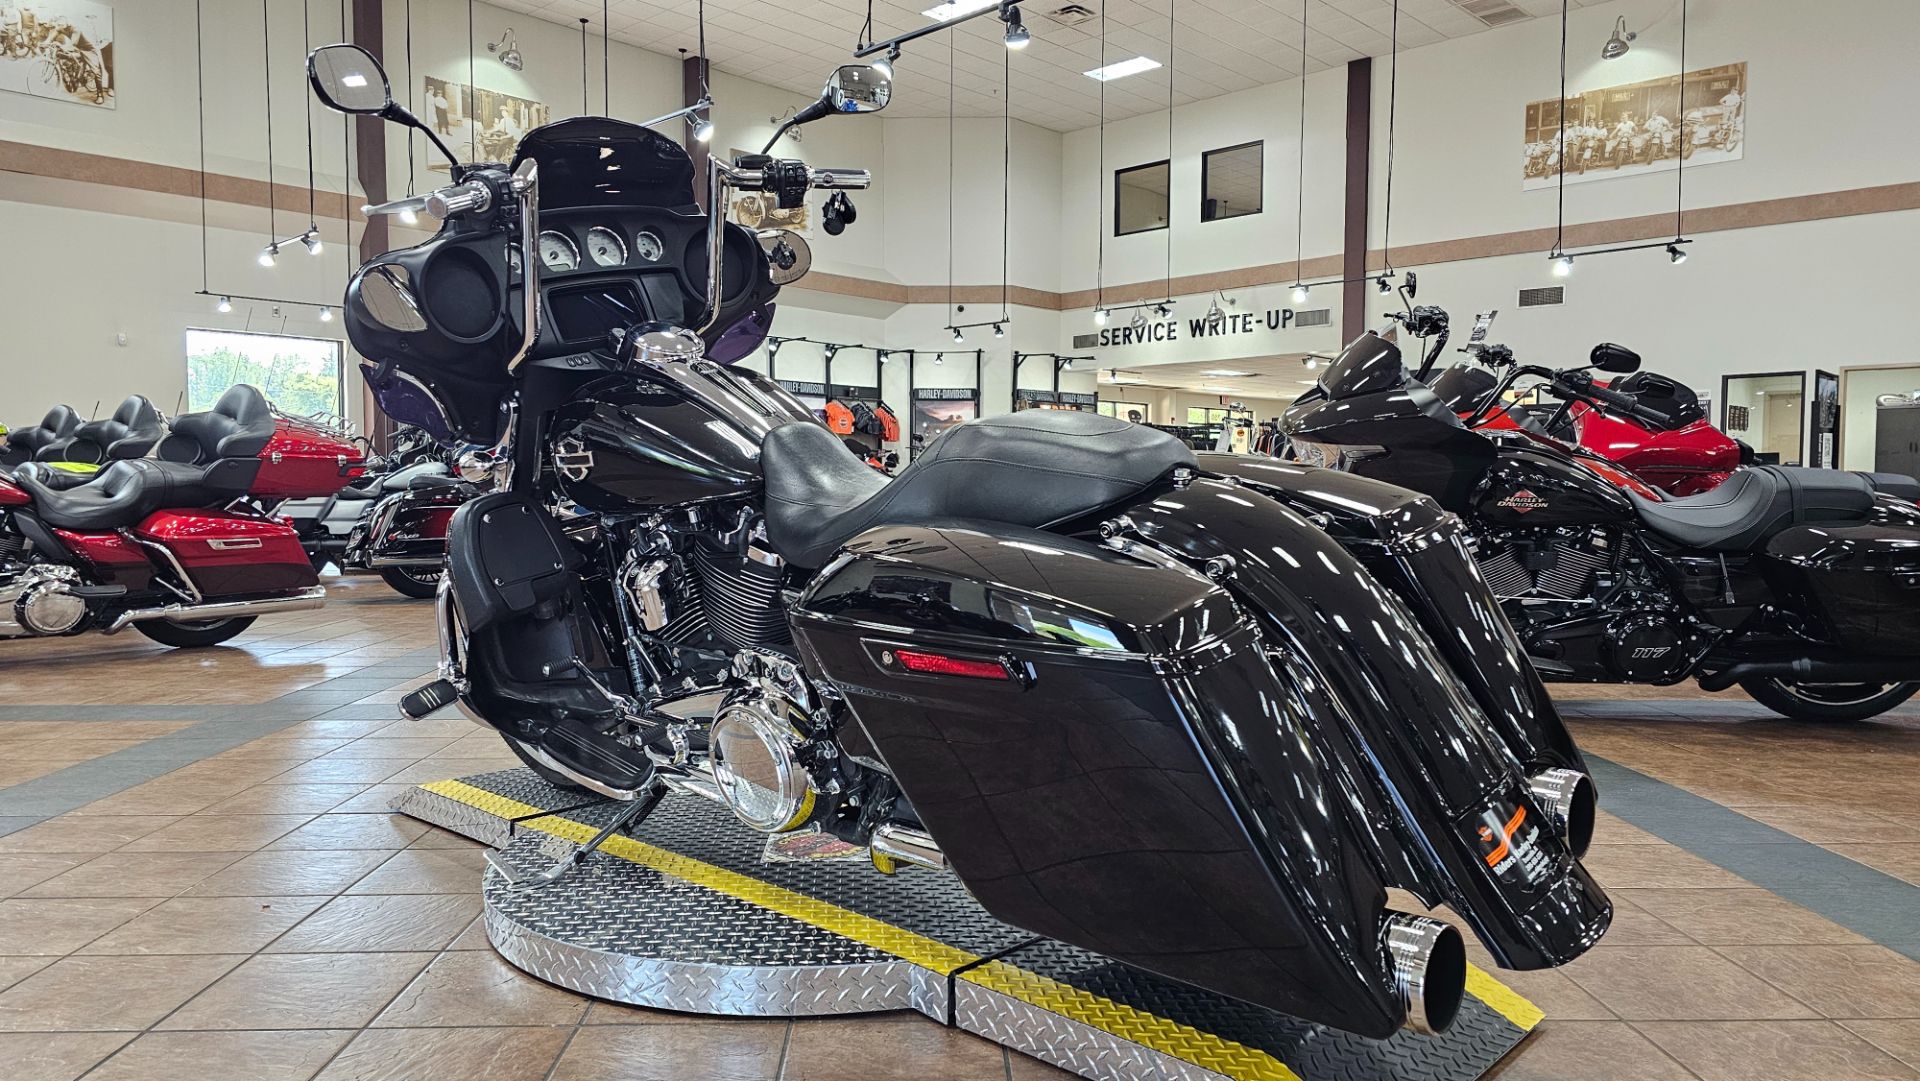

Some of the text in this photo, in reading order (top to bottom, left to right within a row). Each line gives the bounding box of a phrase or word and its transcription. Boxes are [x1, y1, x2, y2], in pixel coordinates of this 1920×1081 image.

[1100, 308, 1294, 347] SERVICE WRITE-UP
[919, 389, 972, 399] HARLEY-DAVIDSON
[1631, 646, 1672, 659] 117
[1493, 855, 1516, 877] Riders
